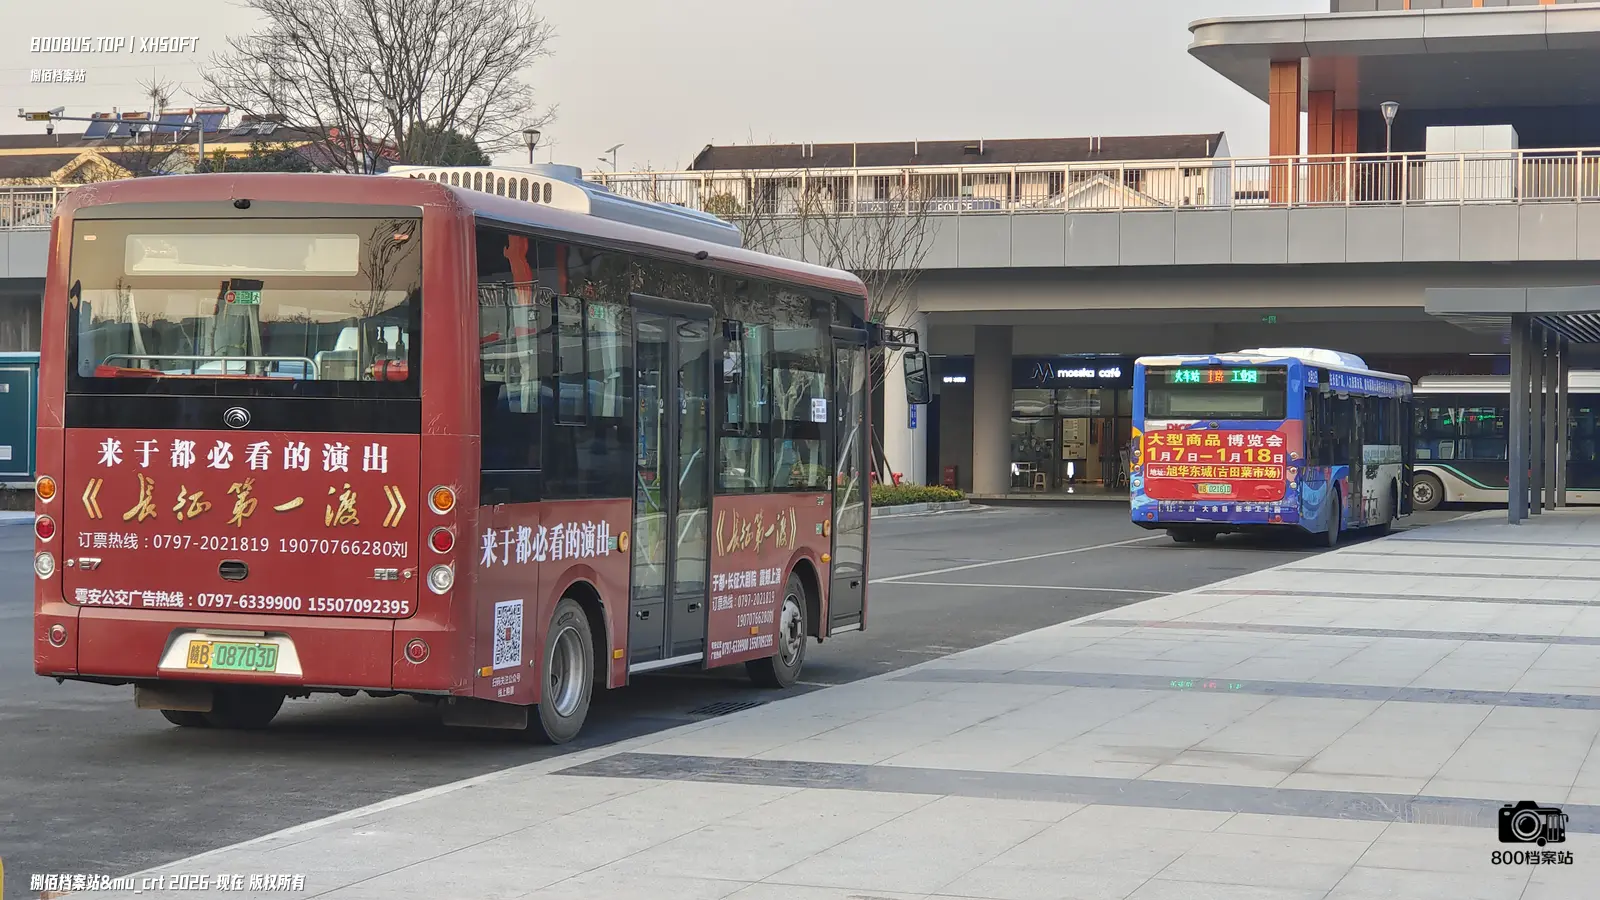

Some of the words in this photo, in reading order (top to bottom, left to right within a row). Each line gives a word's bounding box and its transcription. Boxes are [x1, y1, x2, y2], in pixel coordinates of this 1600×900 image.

[1098, 367, 1121, 378] café
[1174, 369, 1200, 383] 火车站
[1231, 369, 1257, 383] 工业园
[1147, 433, 1221, 446] 大型商品
[1227, 434, 1283, 447] 博览会
[97, 437, 388, 473] 来于都必看的演出
[480, 519, 610, 568] 来于都必看的演出
[308, 597, 410, 615] 15507092395
